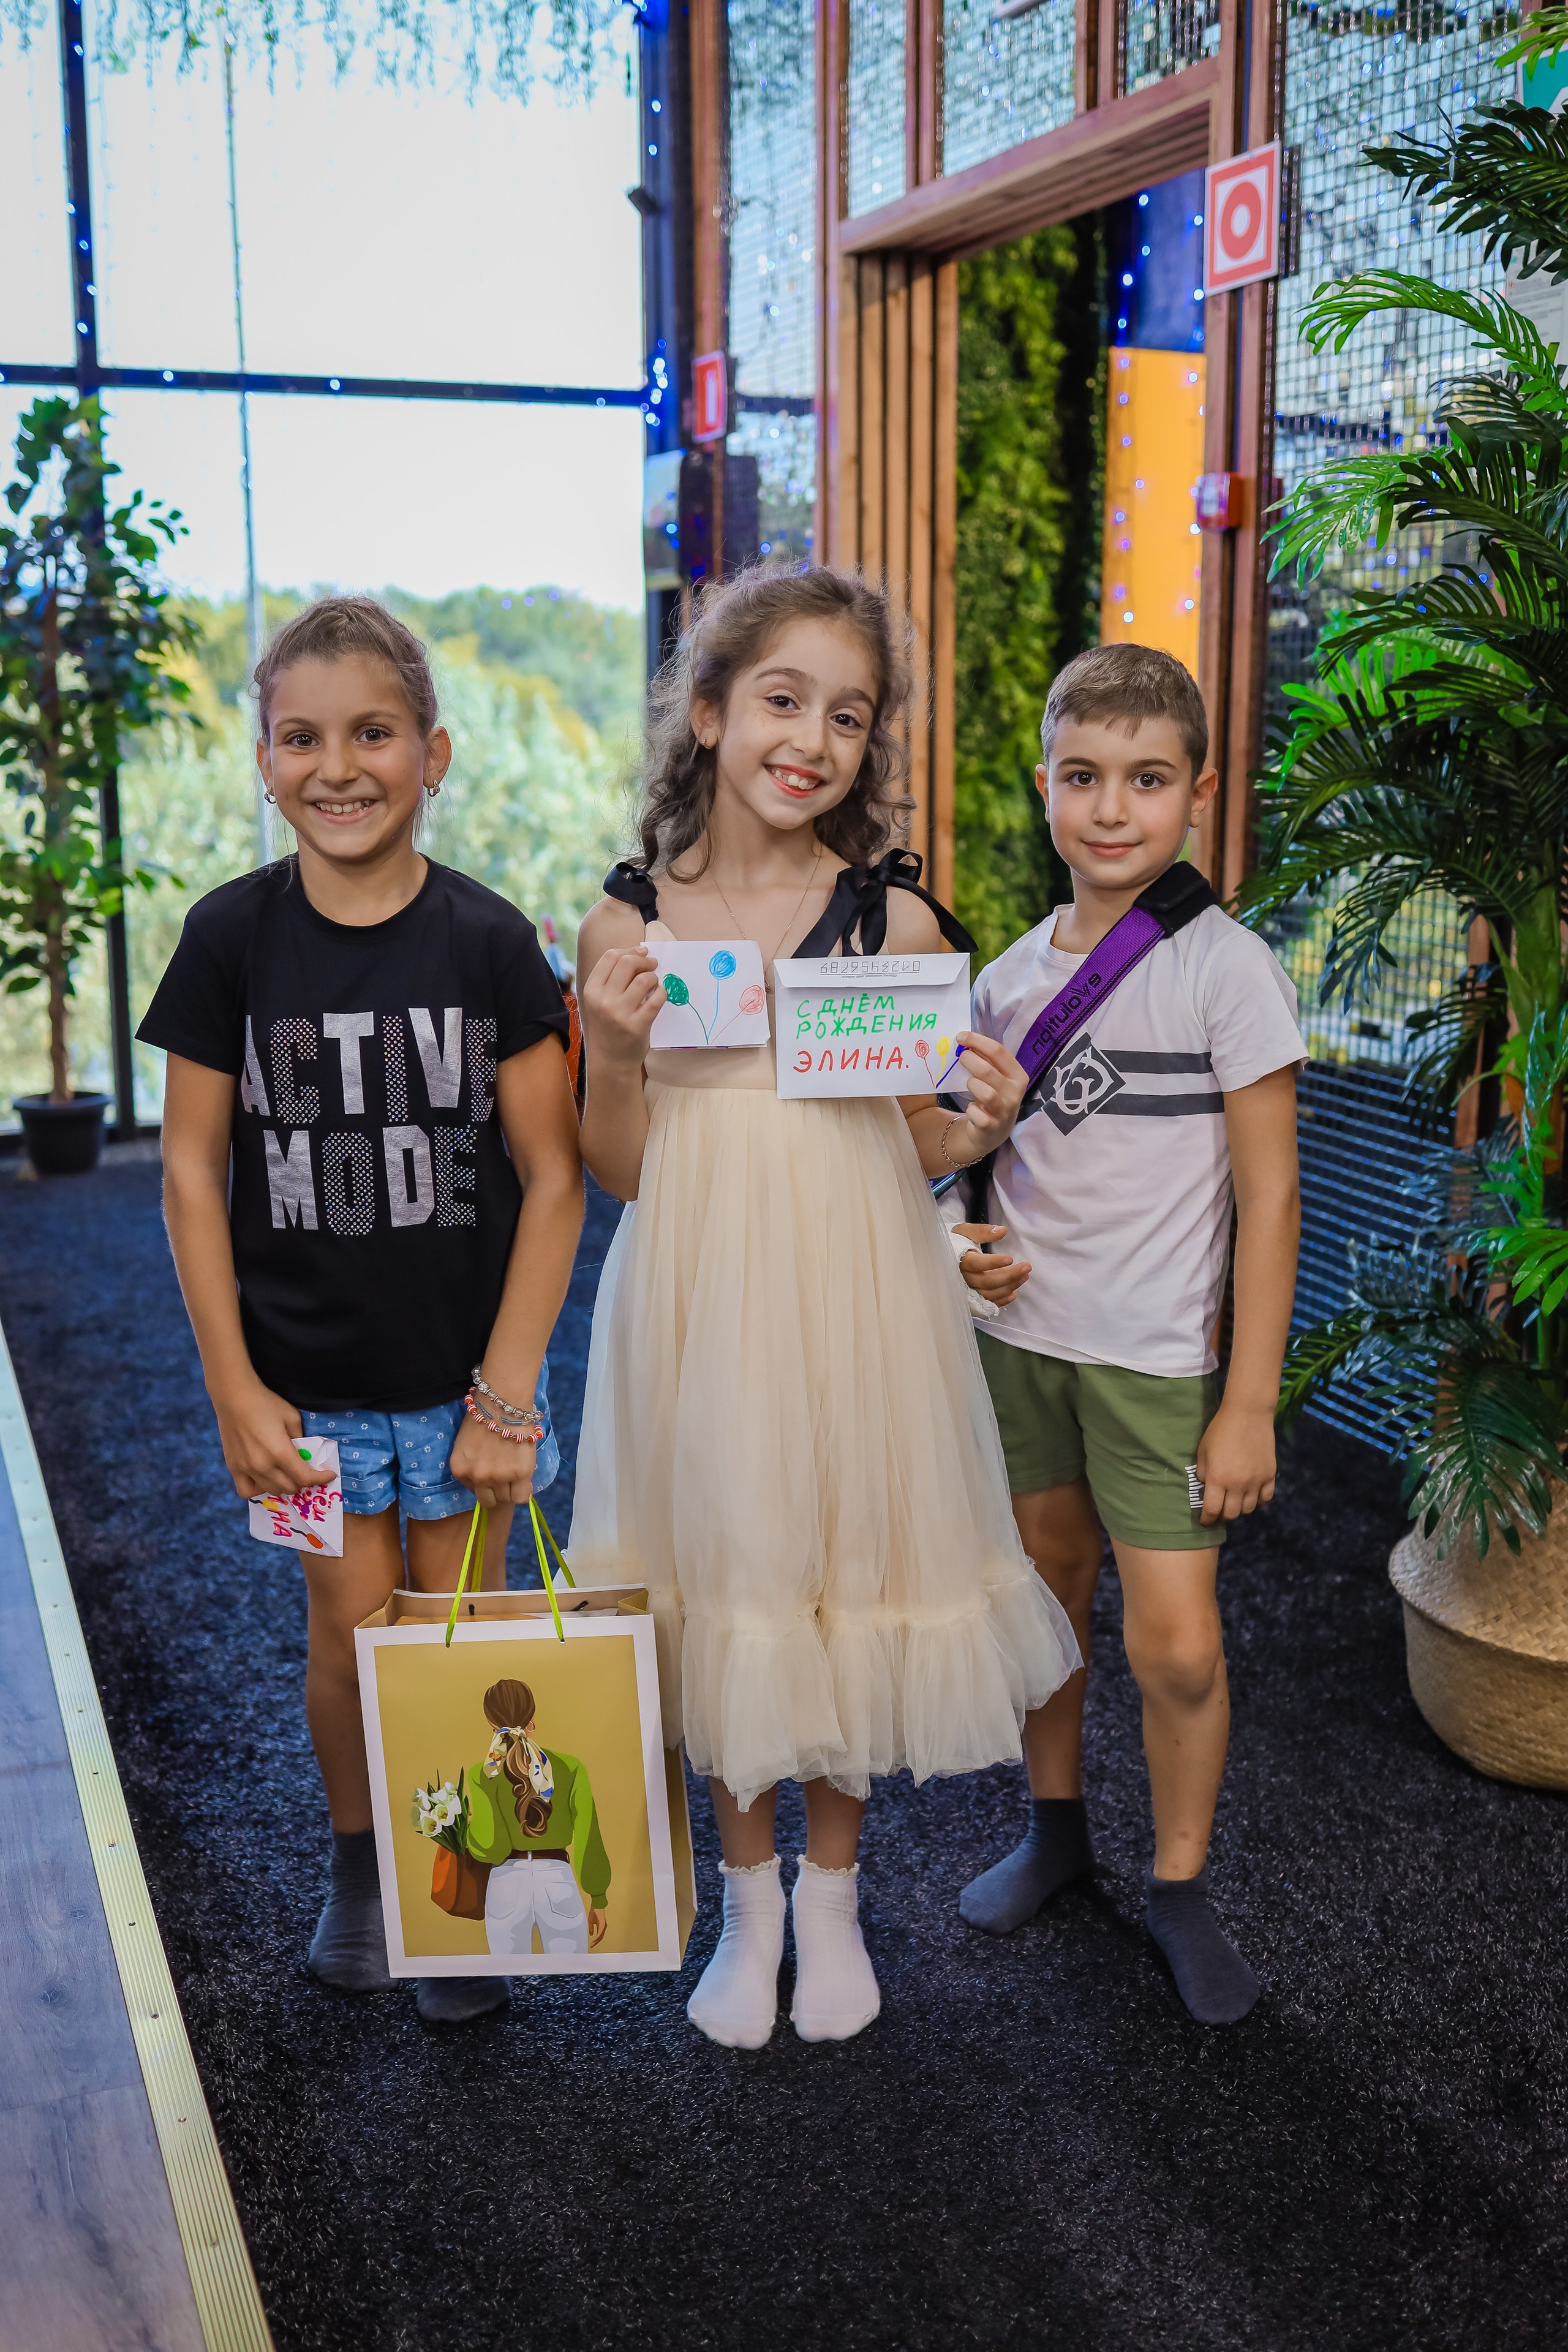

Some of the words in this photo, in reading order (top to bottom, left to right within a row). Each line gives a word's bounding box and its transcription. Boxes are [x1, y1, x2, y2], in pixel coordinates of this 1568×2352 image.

[796, 1013, 938, 1039] РОЖДЕНИЯ
[797, 999, 812, 1019] С
[817, 993, 895, 1020] ДНЁМ
[241, 1007, 497, 1124] ACTIVE
[263, 1125, 478, 1235] MODE
